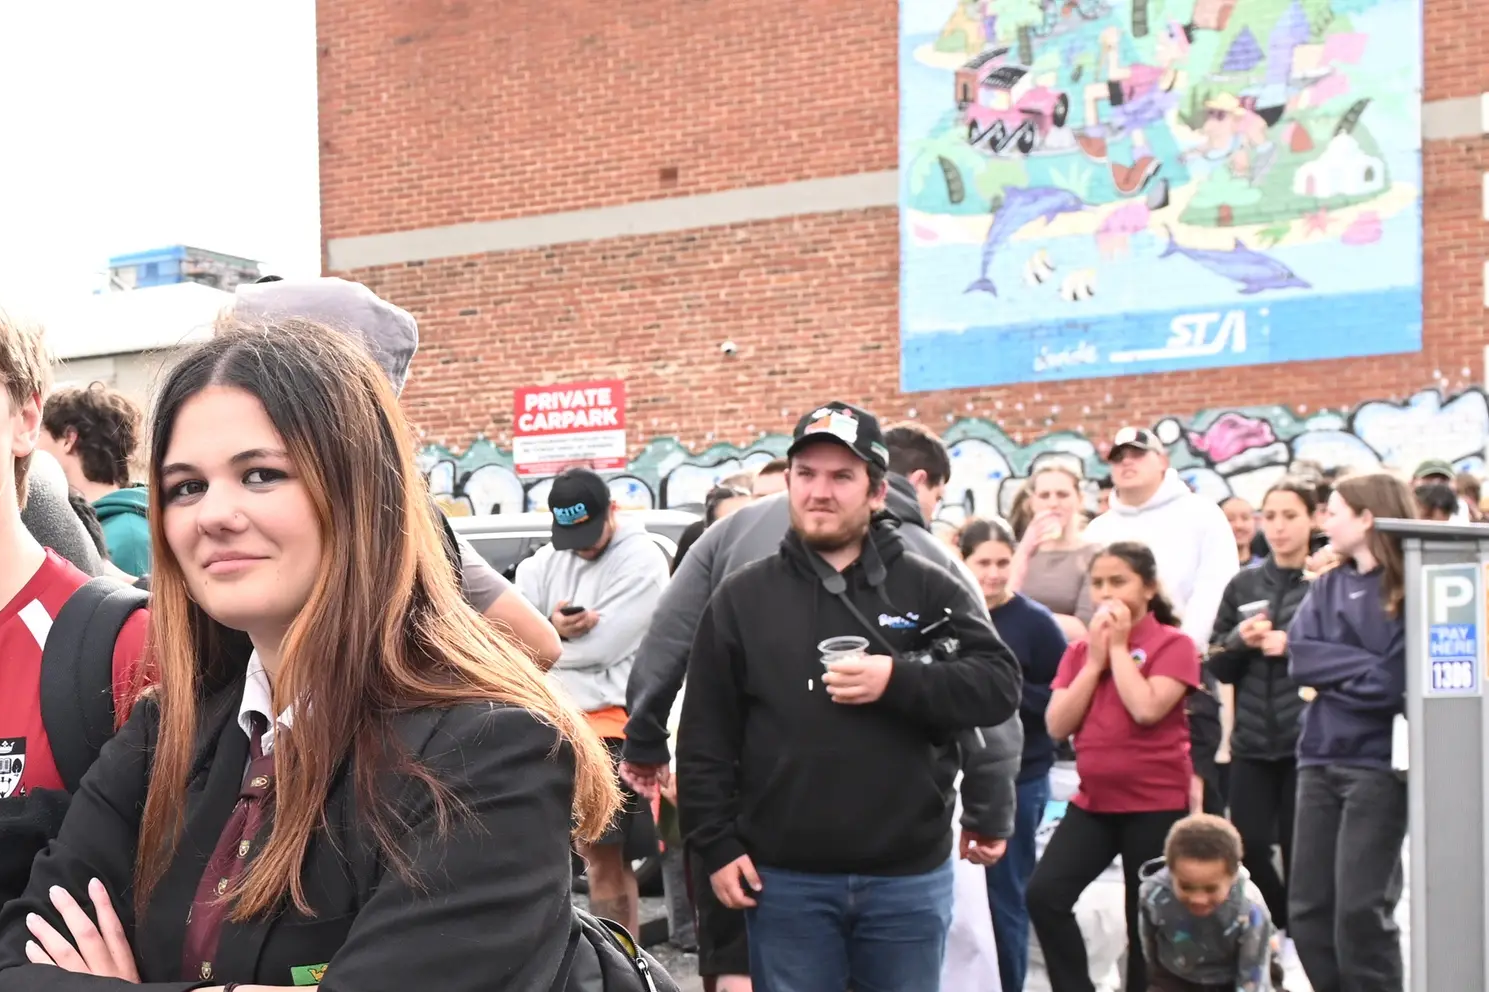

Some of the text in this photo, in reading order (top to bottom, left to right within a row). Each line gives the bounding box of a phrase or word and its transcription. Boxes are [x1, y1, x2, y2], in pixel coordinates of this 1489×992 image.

[525, 388, 612, 410] PRIVATE
[518, 408, 617, 431] CARPARK
[1434, 577, 1474, 623] P
[1438, 627, 1469, 641] PAY
[1432, 641, 1475, 655] HERE
